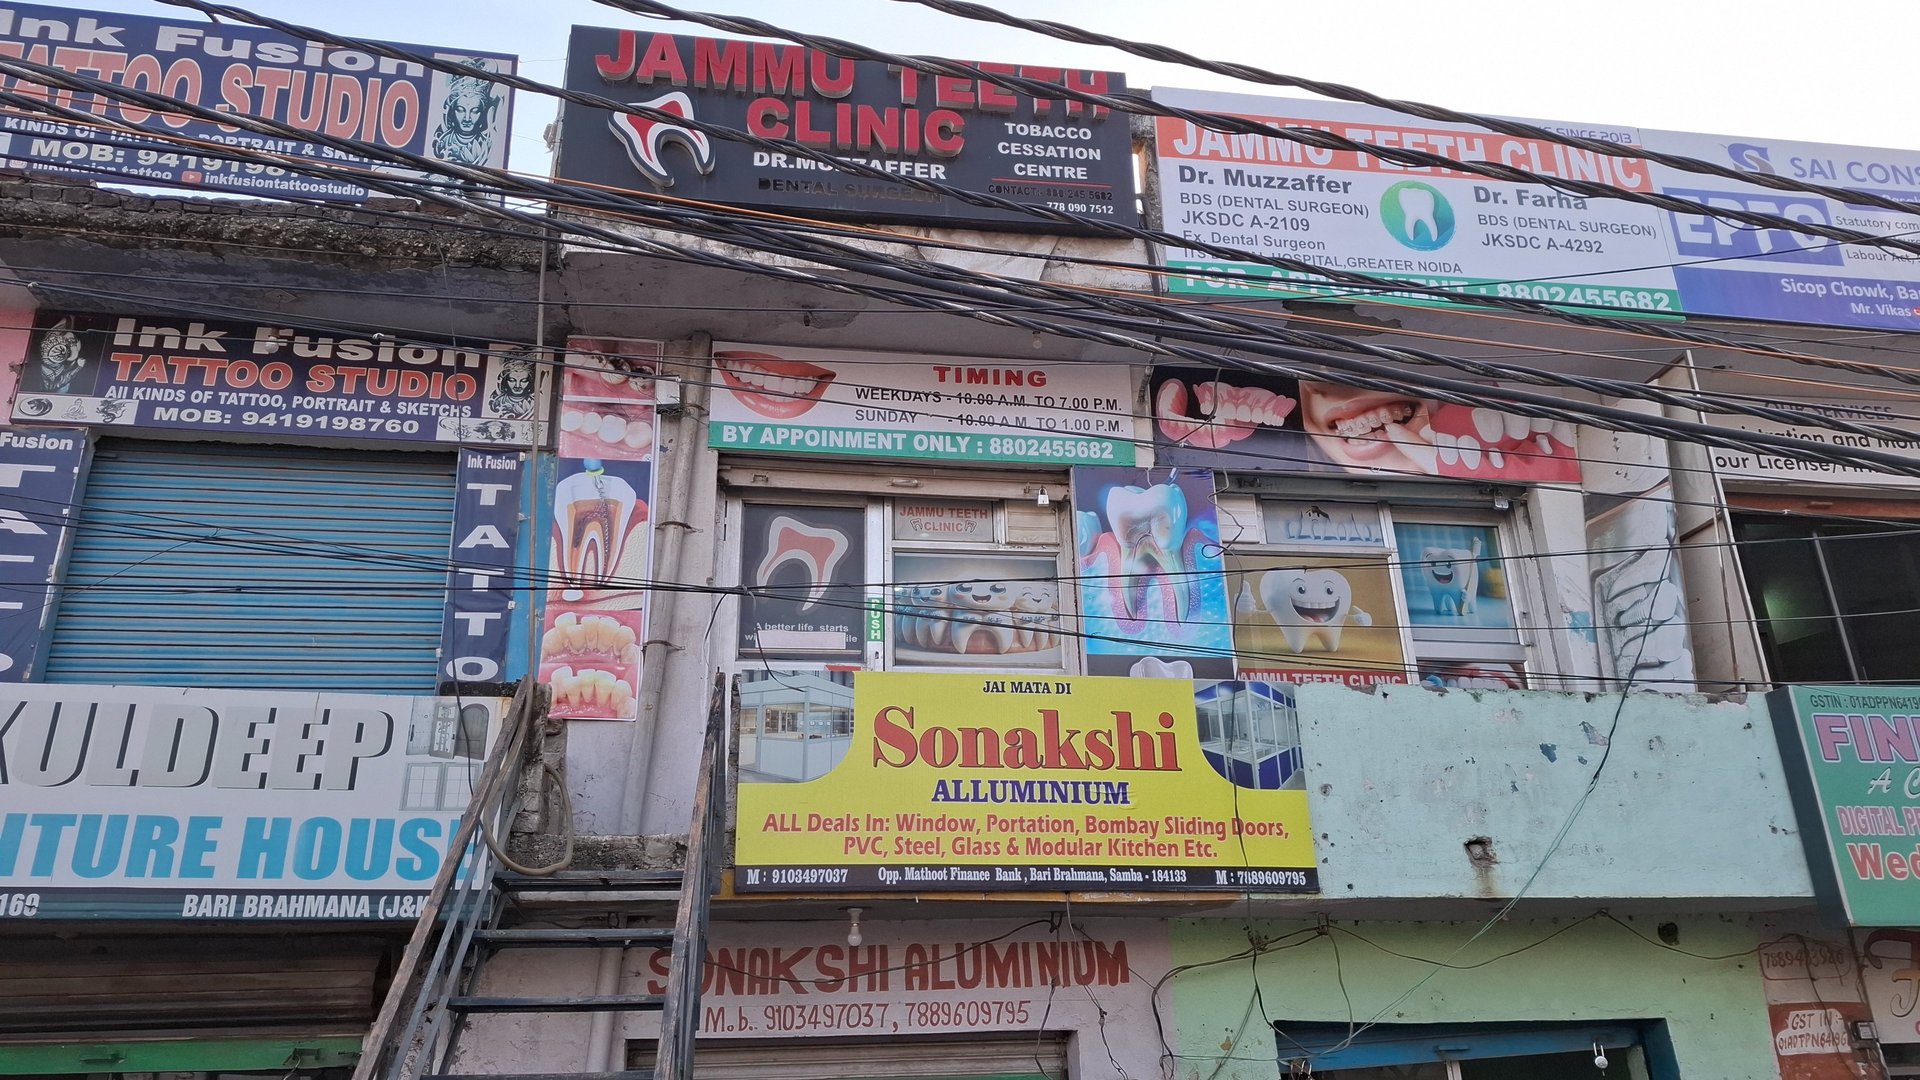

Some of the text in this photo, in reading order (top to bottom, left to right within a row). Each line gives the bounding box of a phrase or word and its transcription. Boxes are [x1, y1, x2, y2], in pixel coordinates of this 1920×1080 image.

[0, 9, 425, 77] Ink Fusion
[595, 29, 1112, 119] JAMMU TEETH
[0, 40, 419, 148] TATTOO STUDIO
[5, 116, 69, 136] KINDS
[747, 97, 965, 158] CLINIC
[1004, 123, 1092, 140] TOBACCO
[30, 140, 125, 163] MOB:
[997, 142, 1101, 160] CESSATION
[1173, 117, 1643, 188] JAMMU TEETH CLINIC
[1013, 163, 1088, 179] CENTRE
[1178, 165, 1352, 194] Dr. Muzzaffer
[1790, 157, 1837, 180] SAI
[204, 172, 365, 197] inkfusiontattoostudio
[1473, 185, 1508, 204] Dr.
[1068, 203, 1087, 213] 090
[1089, 204, 1114, 214] 7512
[1180, 192, 1369, 219] BDS (DENTAL SURGEON)
[1182, 210, 1310, 232] JKSDC A-2109
[1478, 214, 1657, 239] BDS (DENTAL SURGEON)
[1674, 194, 1828, 254] EPFO
[1835, 215, 1891, 231] Statutory
[1211, 232, 1258, 246] Dental
[1263, 235, 1325, 251] Surgeon
[1482, 233, 1604, 254] JKSDC A-4292
[1846, 249, 1887, 261] Labour
[1418, 261, 1463, 274] NOIDA
[1781, 278, 1894, 301] Sicop Chowk,
[1850, 302, 1912, 317] Mr. Vikas
[113, 317, 481, 368] Ink Fusion
[110, 352, 477, 401] TATTOO STUDIO
[933, 366, 1047, 388] TIMING
[105, 386, 472, 418] All KINDS OF TATTOO, PORTRAIT & SKETCHS
[855, 387, 942, 403] WEEKDAYS
[957, 392, 994, 405] 10.00
[1035, 395, 1055, 408] TO
[1059, 396, 1089, 409] 7.00
[1093, 398, 1122, 411] P.M.
[153, 407, 420, 434] MOB: 9419198760
[855, 409, 917, 424] SUNDAY
[957, 414, 995, 427] 10.00
[1036, 417, 1057, 430] TO
[1061, 418, 1091, 431] 1.00
[1095, 419, 1124, 433] P.M.
[0, 432, 73, 451] Fusion
[723, 425, 1114, 459] BY APPOINMENT ONLY 8802455682
[467, 454, 517, 470] Ink Fusion
[900, 506, 988, 519] JAMMU TEETH
[924, 521, 963, 532] CLINIC
[764, 622, 849, 632] better life starts
[983, 681, 1072, 695] JAI MATA DI
[1810, 695, 1920, 709] GSTIN 01ADPPN6419
[872, 705, 1183, 772] Sonakshi
[931, 779, 1131, 805] ALLUMINIUM
[762, 813, 1289, 841] ALL Deals In: Window, Portation, Bombay Sliding Doors,
[1835, 805, 1906, 836] DIGITAL
[843, 836, 1218, 858] PVC, Steel, Glass & Modular Kitchen Etc.
[747, 867, 1306, 886] M 9103497037 Opp. Mathoot Finance Bank Bari Brahmana, Samba 184133 M 7889609795
[182, 894, 237, 918] BARI
[241, 895, 370, 919] BRAHMANA
[905, 940, 1130, 991] ALUMINIUM
